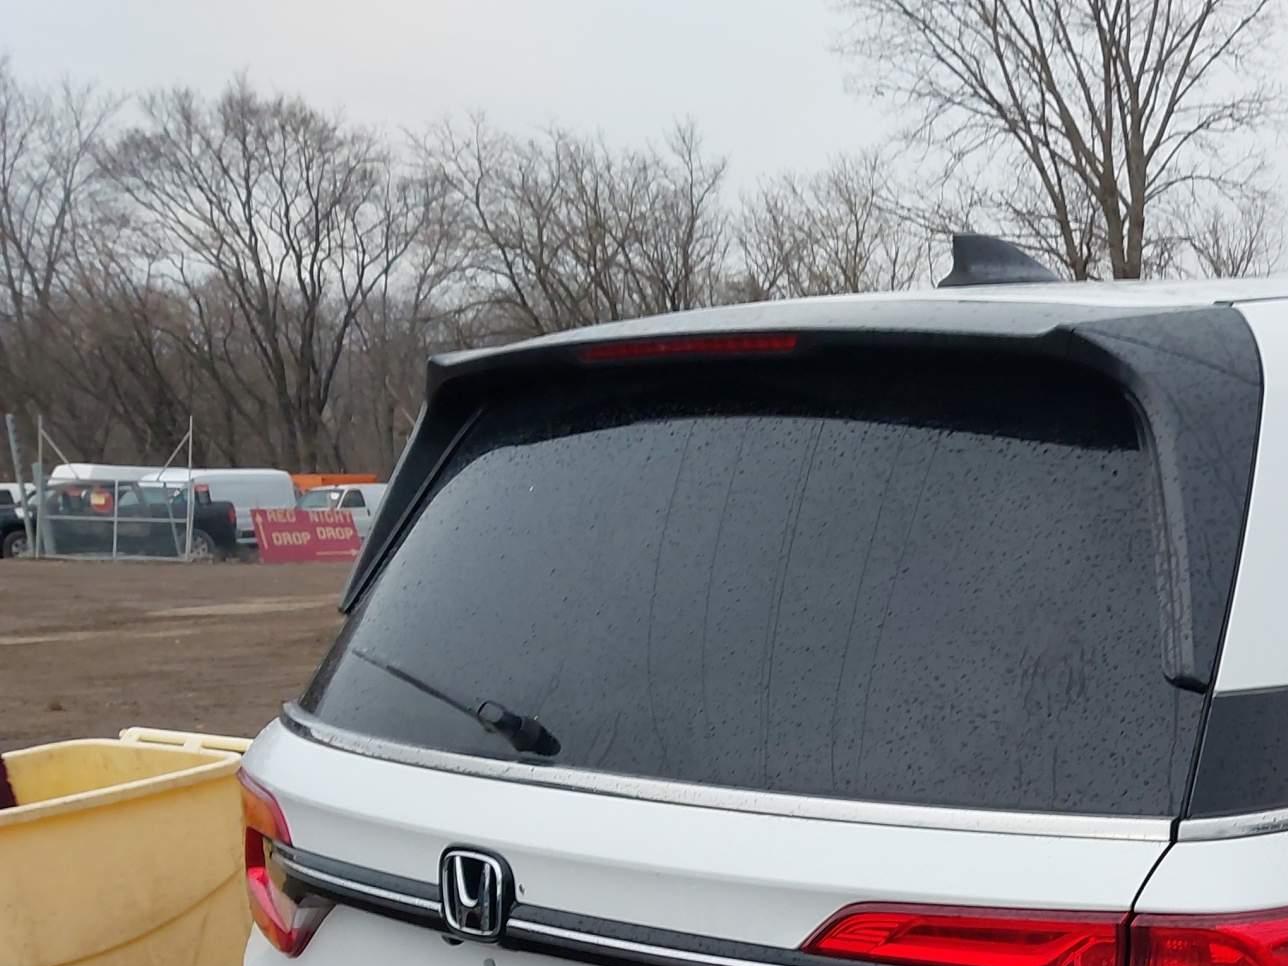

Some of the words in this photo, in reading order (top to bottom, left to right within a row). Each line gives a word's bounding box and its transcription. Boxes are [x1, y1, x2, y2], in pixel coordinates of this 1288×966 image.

[266, 511, 297, 523] RED
[308, 511, 353, 523] NIGHT
[271, 532, 311, 545] DROP
[315, 527, 354, 540] DROP
